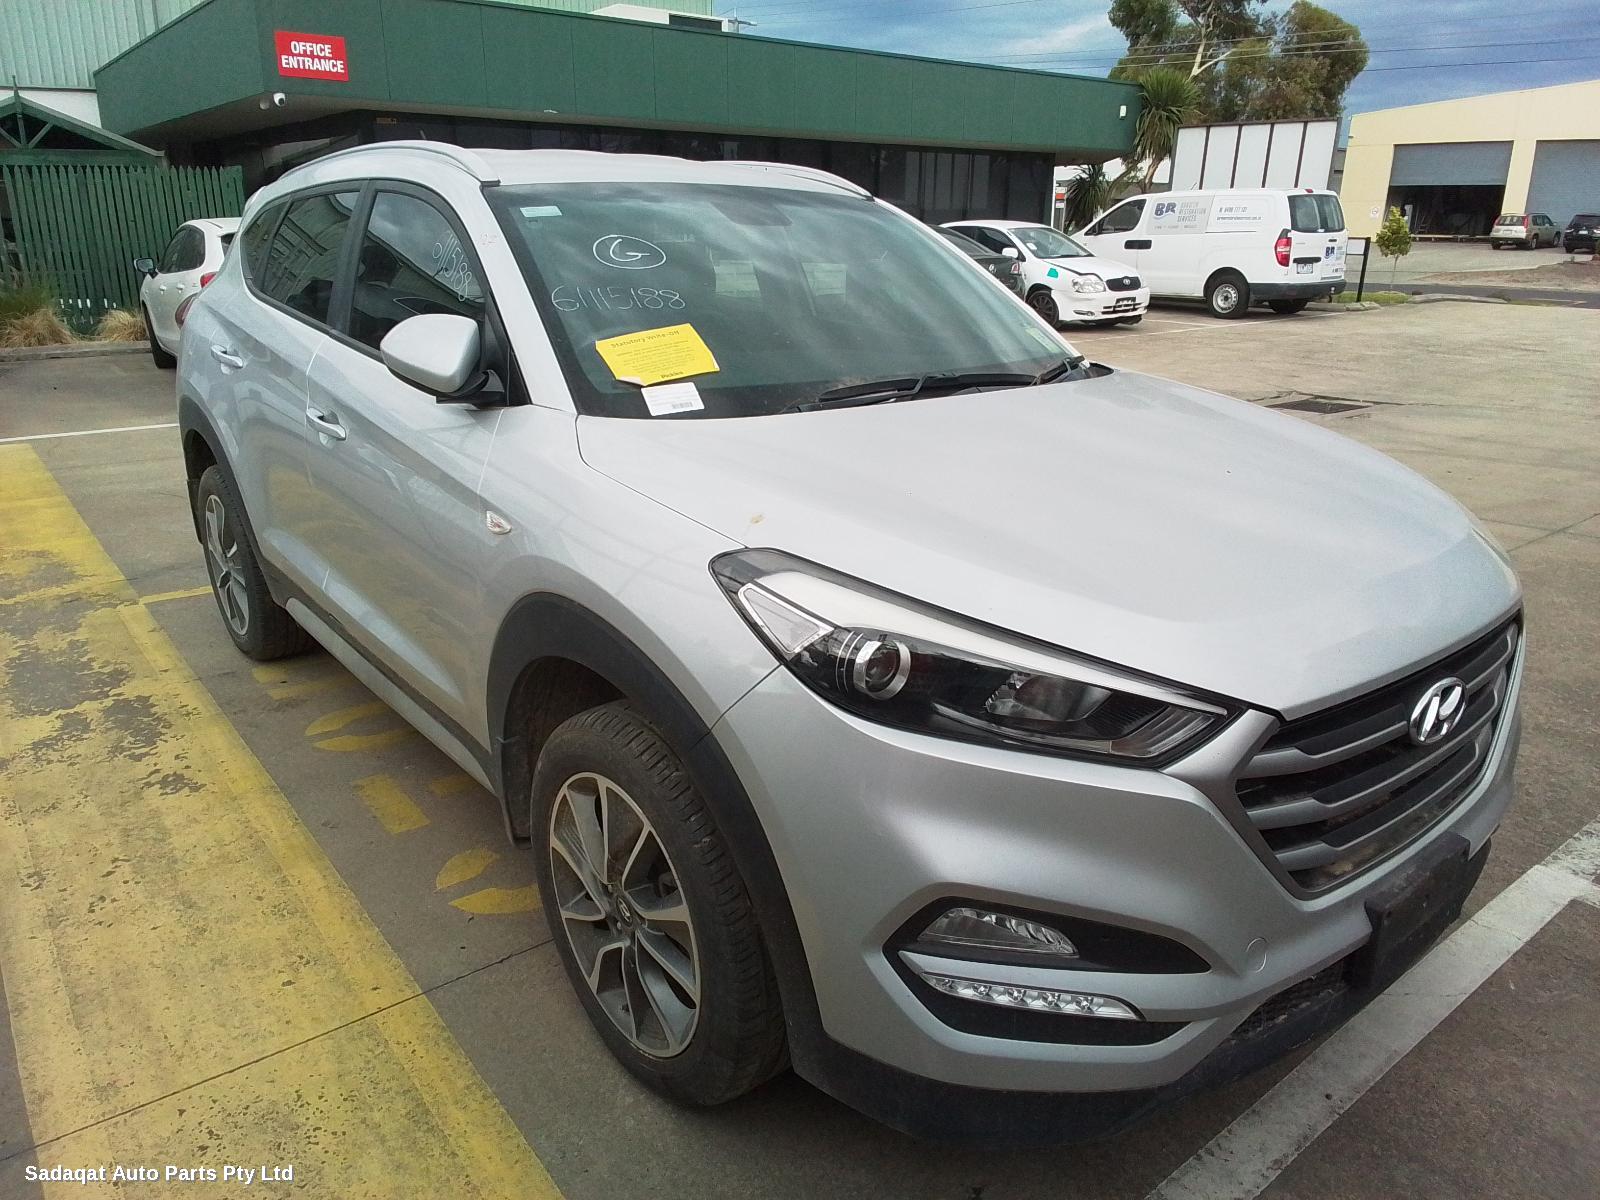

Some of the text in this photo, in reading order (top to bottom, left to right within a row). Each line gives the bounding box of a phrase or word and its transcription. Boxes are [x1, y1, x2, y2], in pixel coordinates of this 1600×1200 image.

[290, 41, 332, 57] OFFICE
[281, 54, 344, 73] ENTRANCE
[1154, 202, 1176, 216] BR
[551, 285, 686, 312] 61115188
